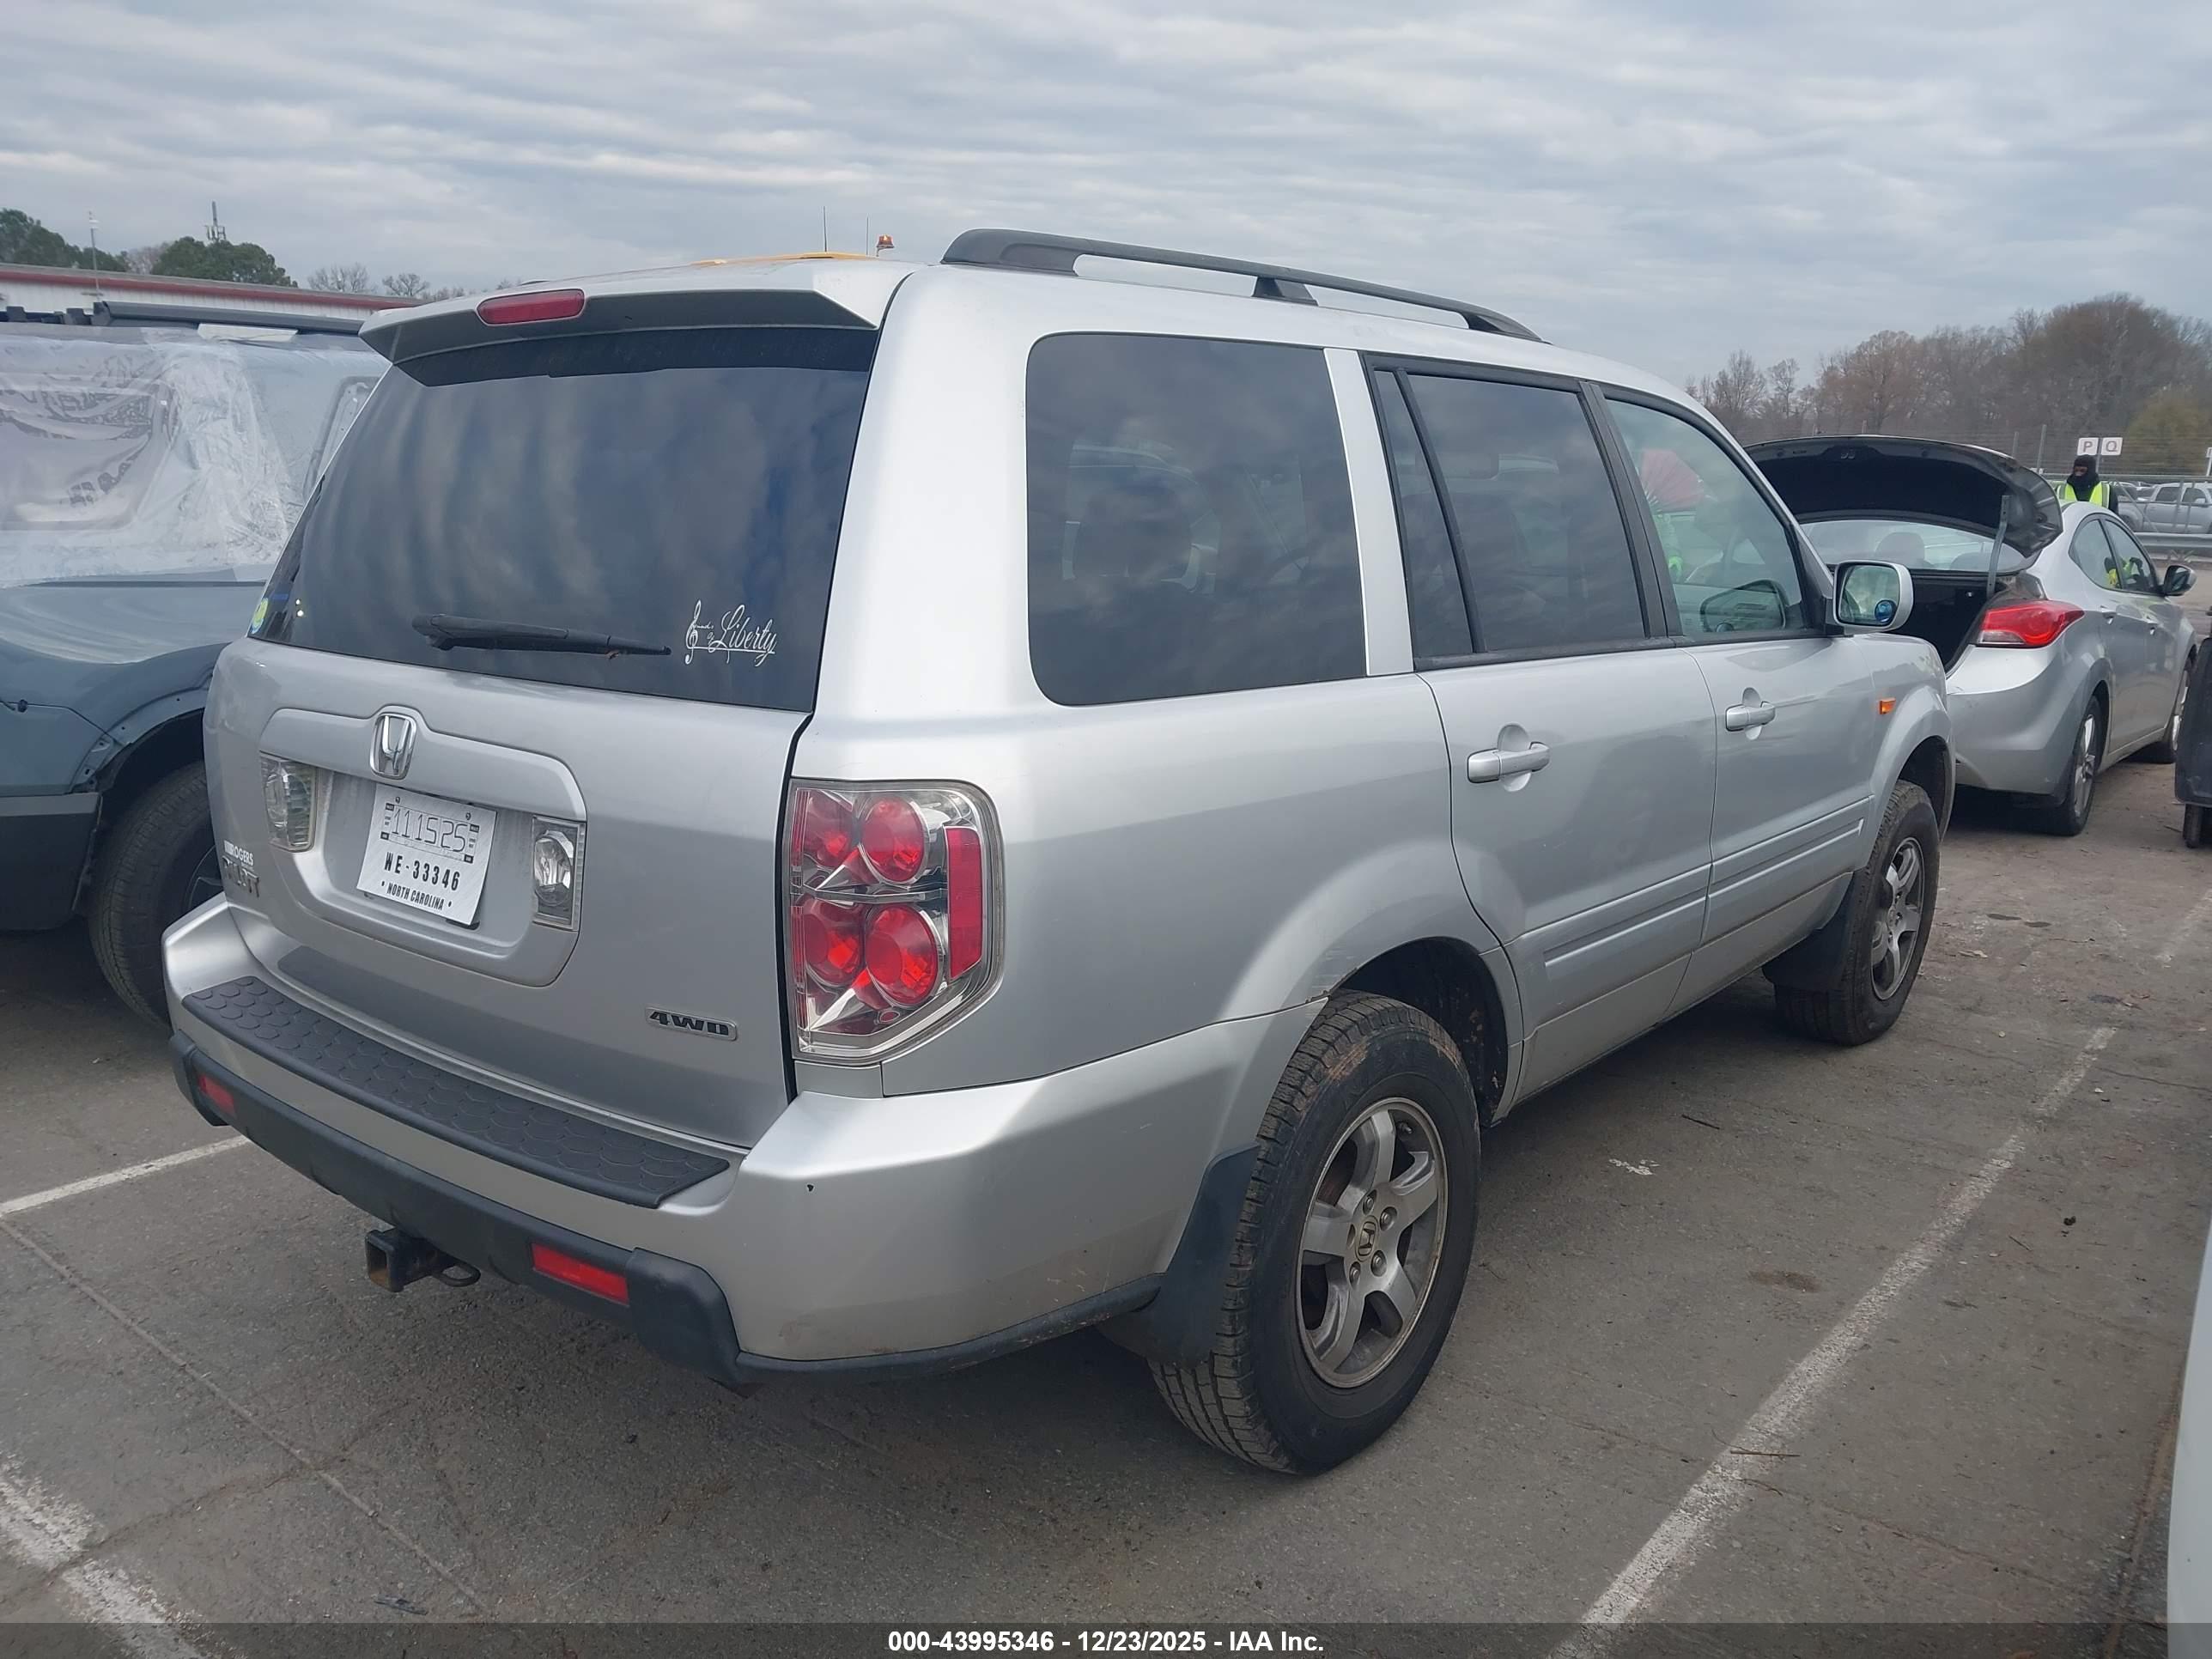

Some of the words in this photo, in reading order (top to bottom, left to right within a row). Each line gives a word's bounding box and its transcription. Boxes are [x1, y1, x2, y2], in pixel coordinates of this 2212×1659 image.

[2083, 441, 2093, 453] P
[2106, 441, 2118, 452] Q
[708, 605, 776, 666] Liberty
[387, 883, 410, 900] NORTH
[410, 890, 444, 910] CAROLINA
[649, 1011, 729, 1036] 4WD
